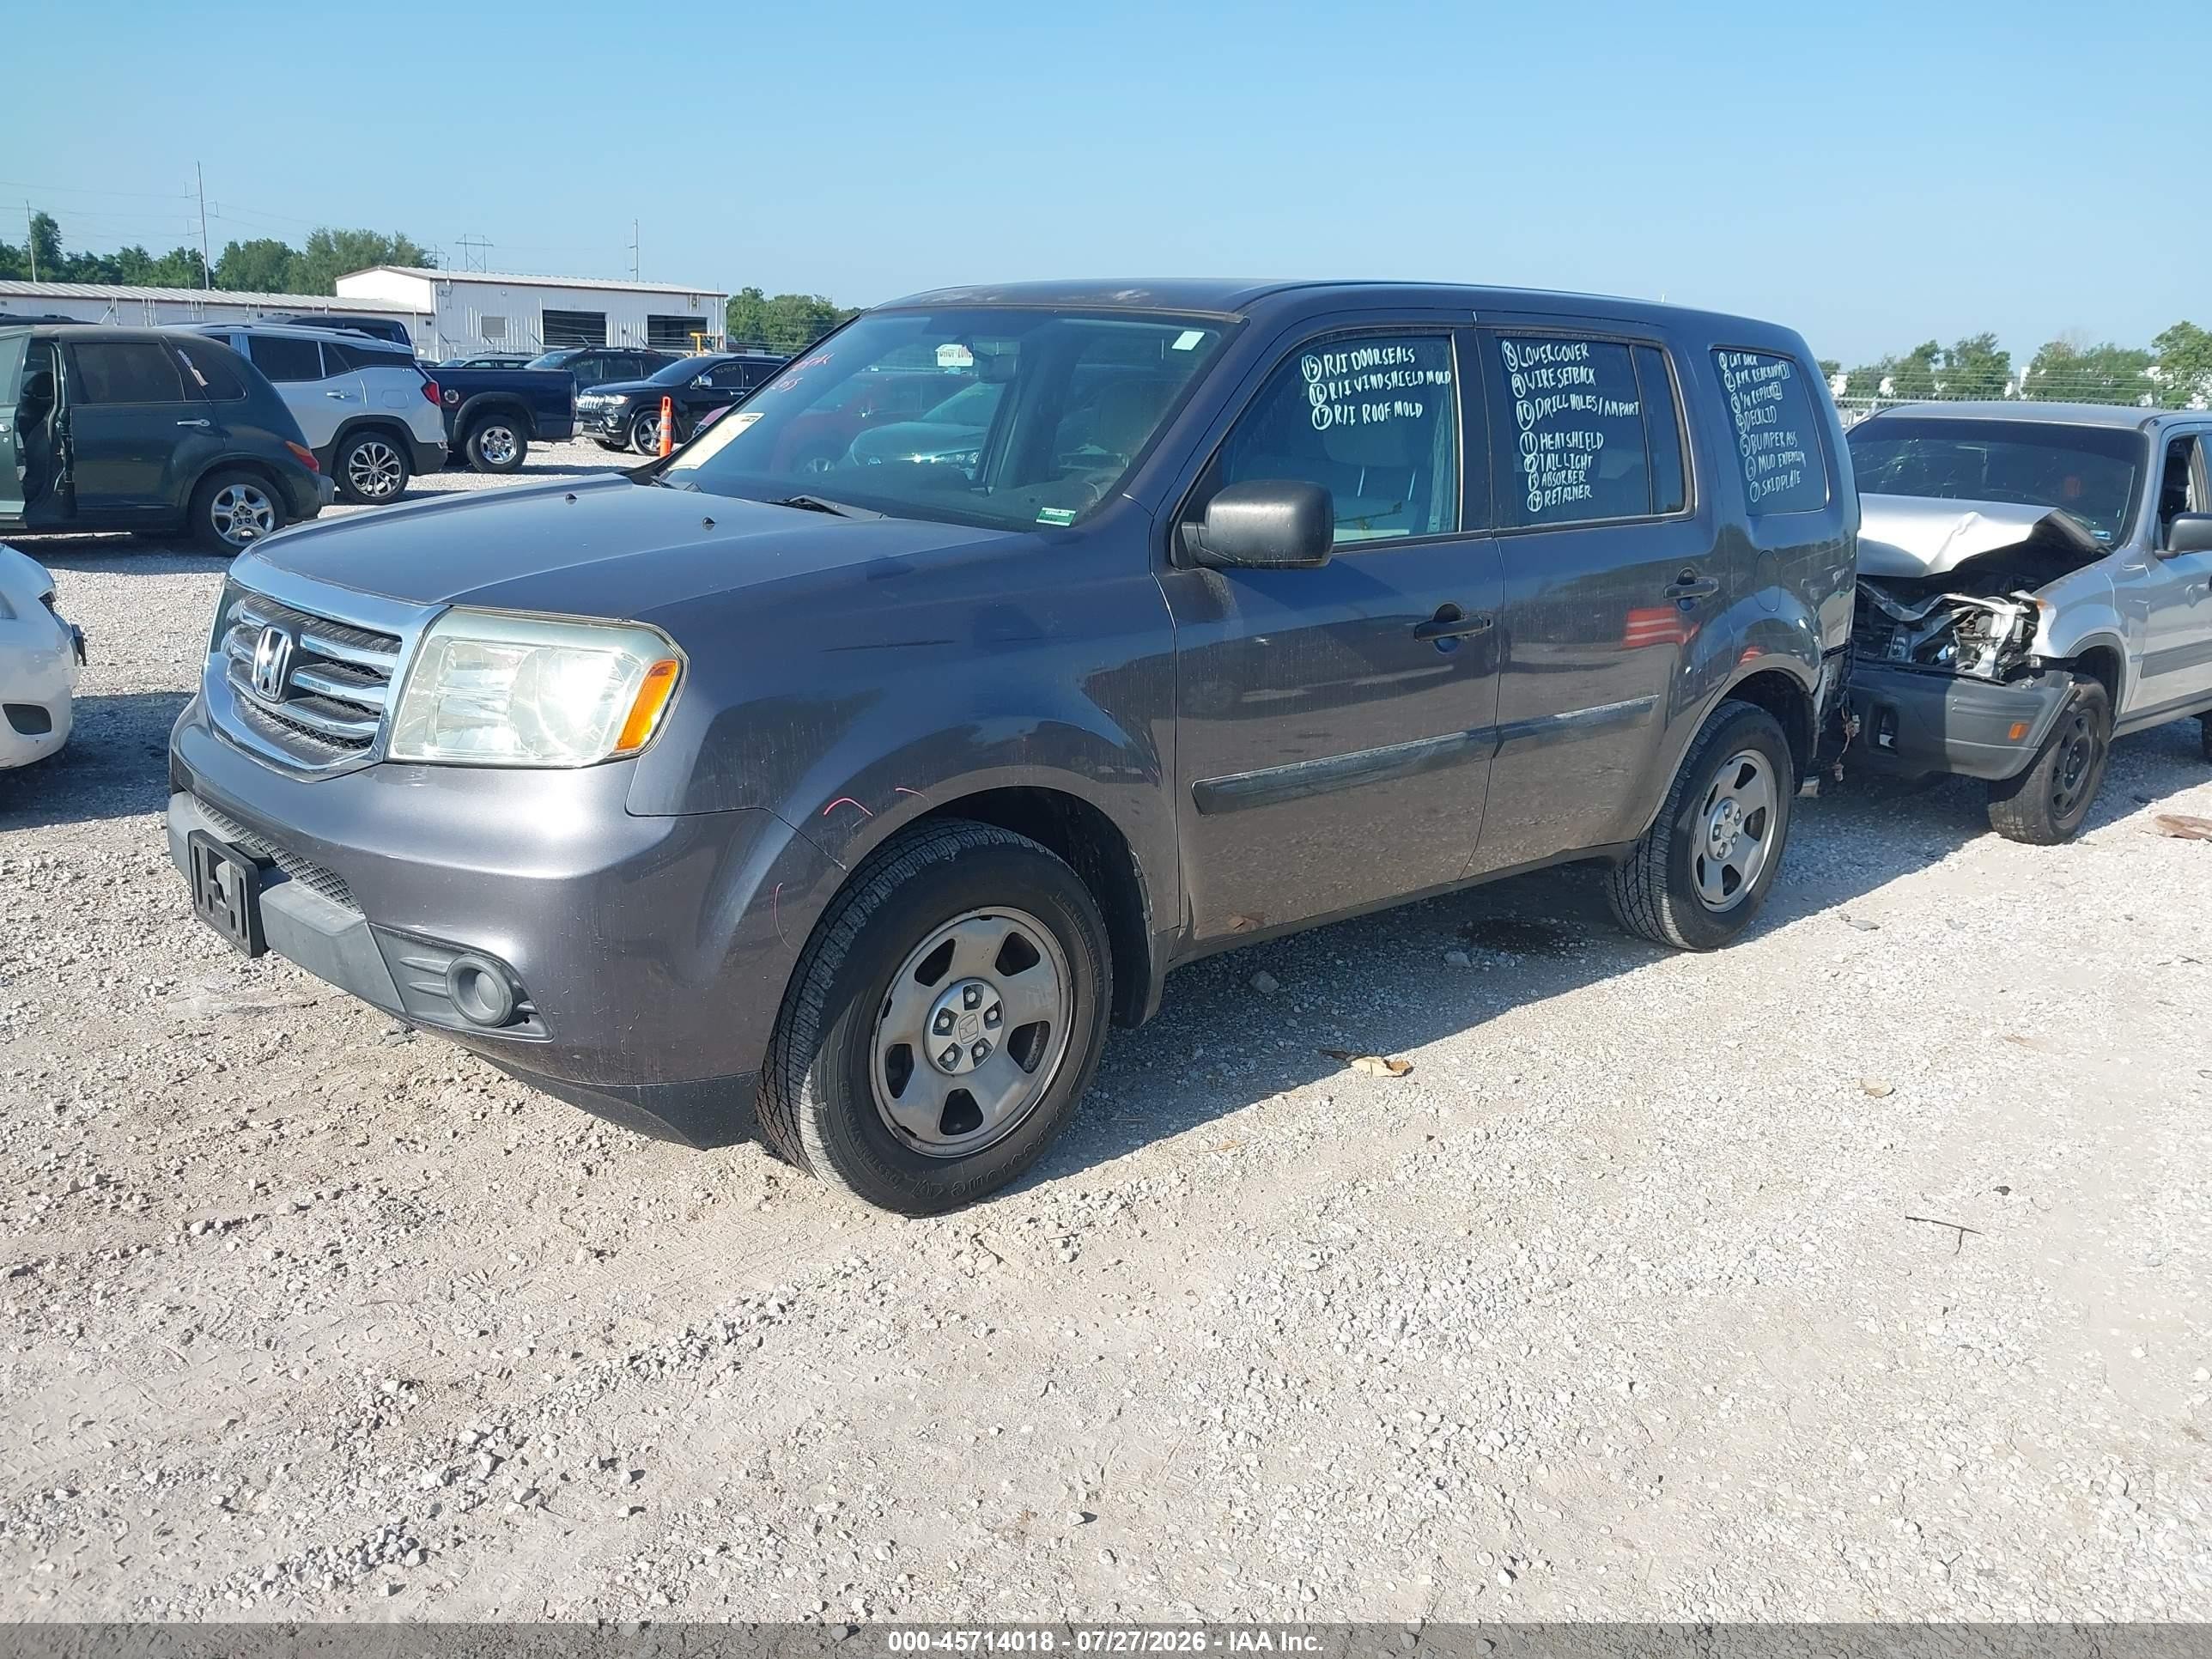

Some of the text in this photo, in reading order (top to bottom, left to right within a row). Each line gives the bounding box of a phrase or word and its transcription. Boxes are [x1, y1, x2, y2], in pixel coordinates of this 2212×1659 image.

[1362, 401, 1391, 424] ROOF
[1394, 400, 1423, 418] MOLD
[1750, 431, 1785, 455] BUMPER
[1758, 453, 1776, 474] MUD
[1541, 470, 1586, 487] ABSORBER
[1544, 484, 1593, 507] RETAINER
